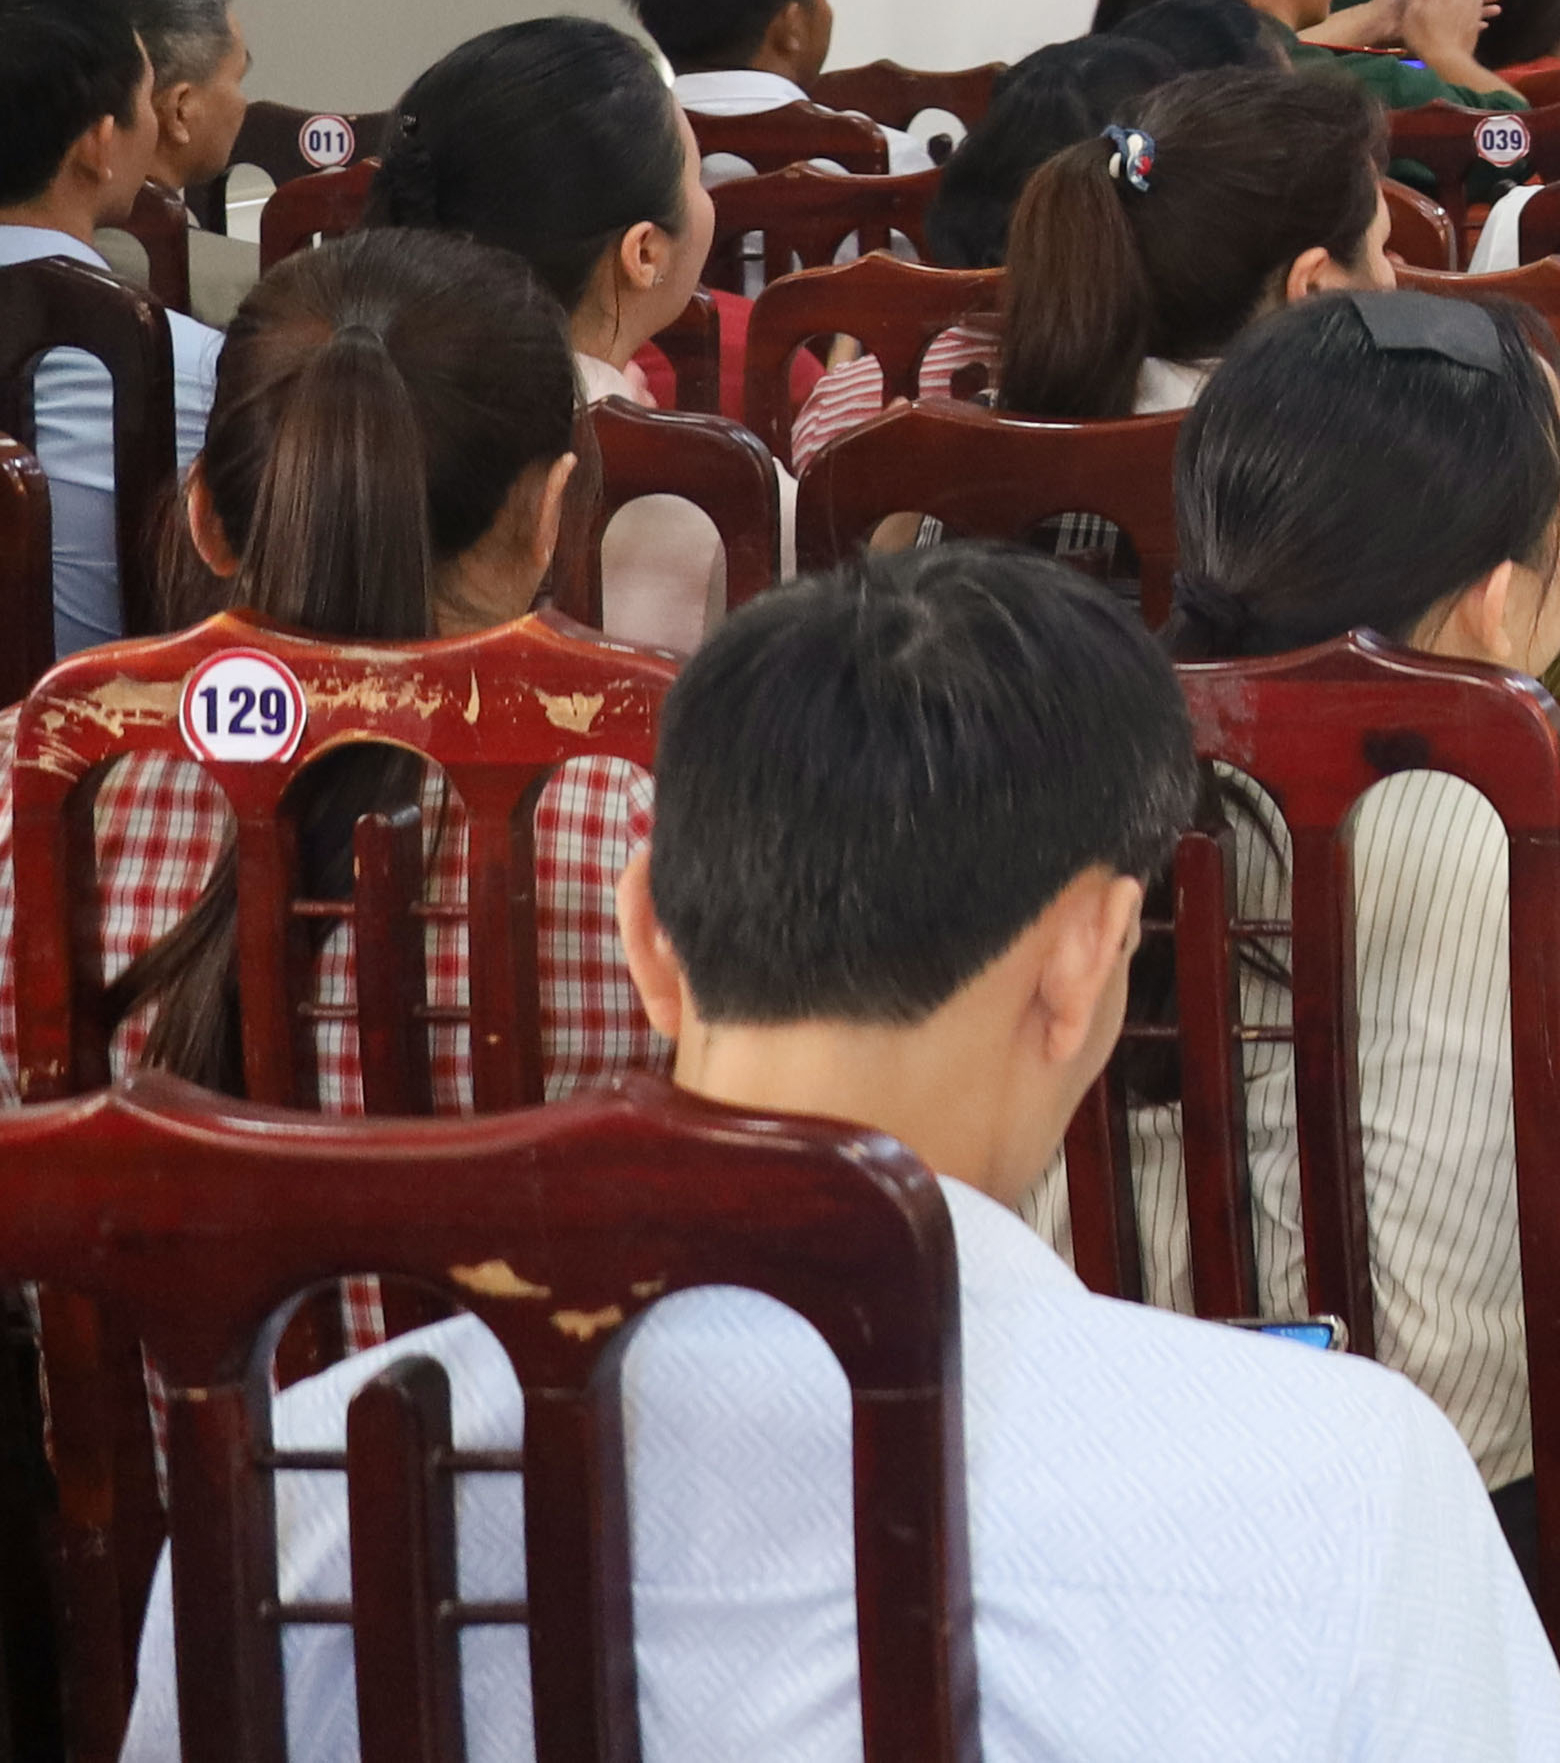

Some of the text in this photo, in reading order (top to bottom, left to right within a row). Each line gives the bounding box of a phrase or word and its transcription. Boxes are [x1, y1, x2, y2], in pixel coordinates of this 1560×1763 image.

[310, 129, 346, 153] 011
[1482, 129, 1523, 150] 039
[199, 686, 288, 736] 129
